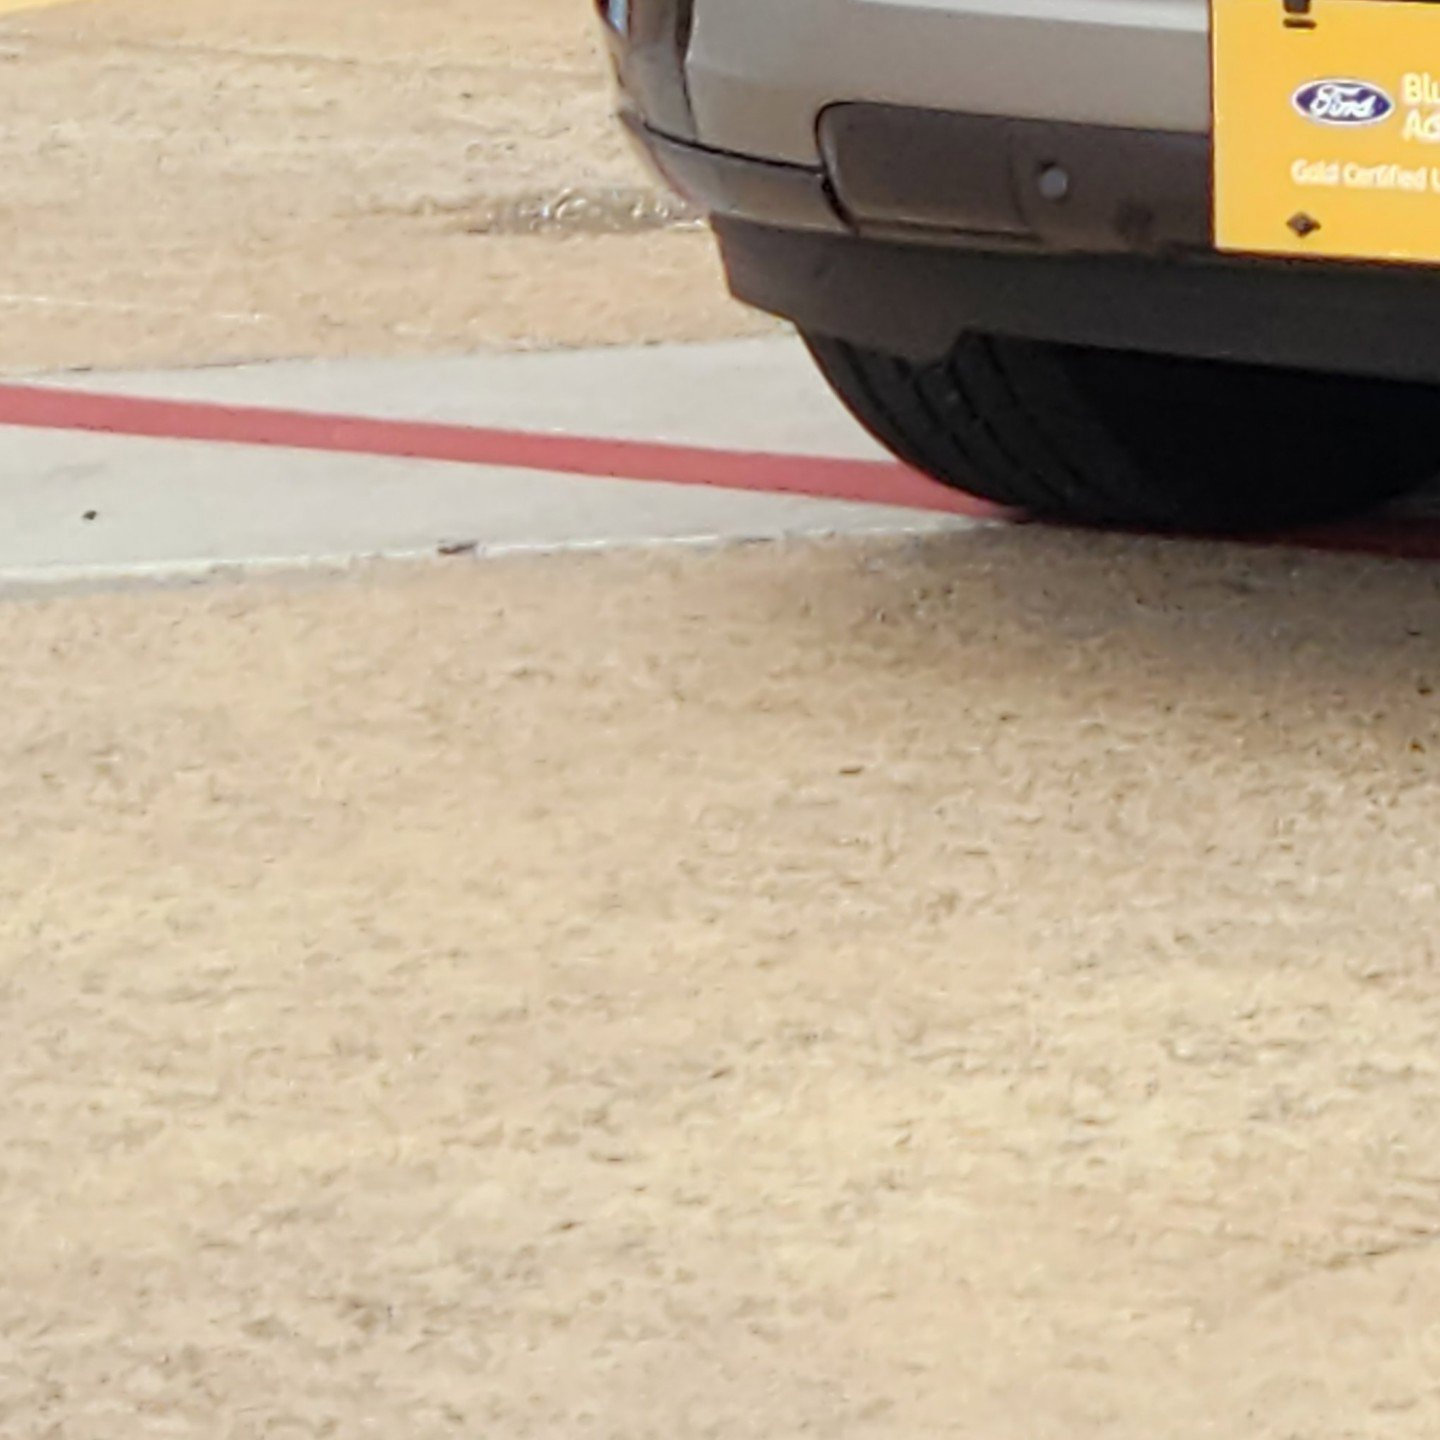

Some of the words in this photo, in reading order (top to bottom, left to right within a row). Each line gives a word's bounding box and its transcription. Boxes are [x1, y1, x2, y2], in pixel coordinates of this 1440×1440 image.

[1310, 83, 1378, 118] Ford
[1291, 159, 1340, 186] Gold
[1343, 161, 1428, 193] Certified
